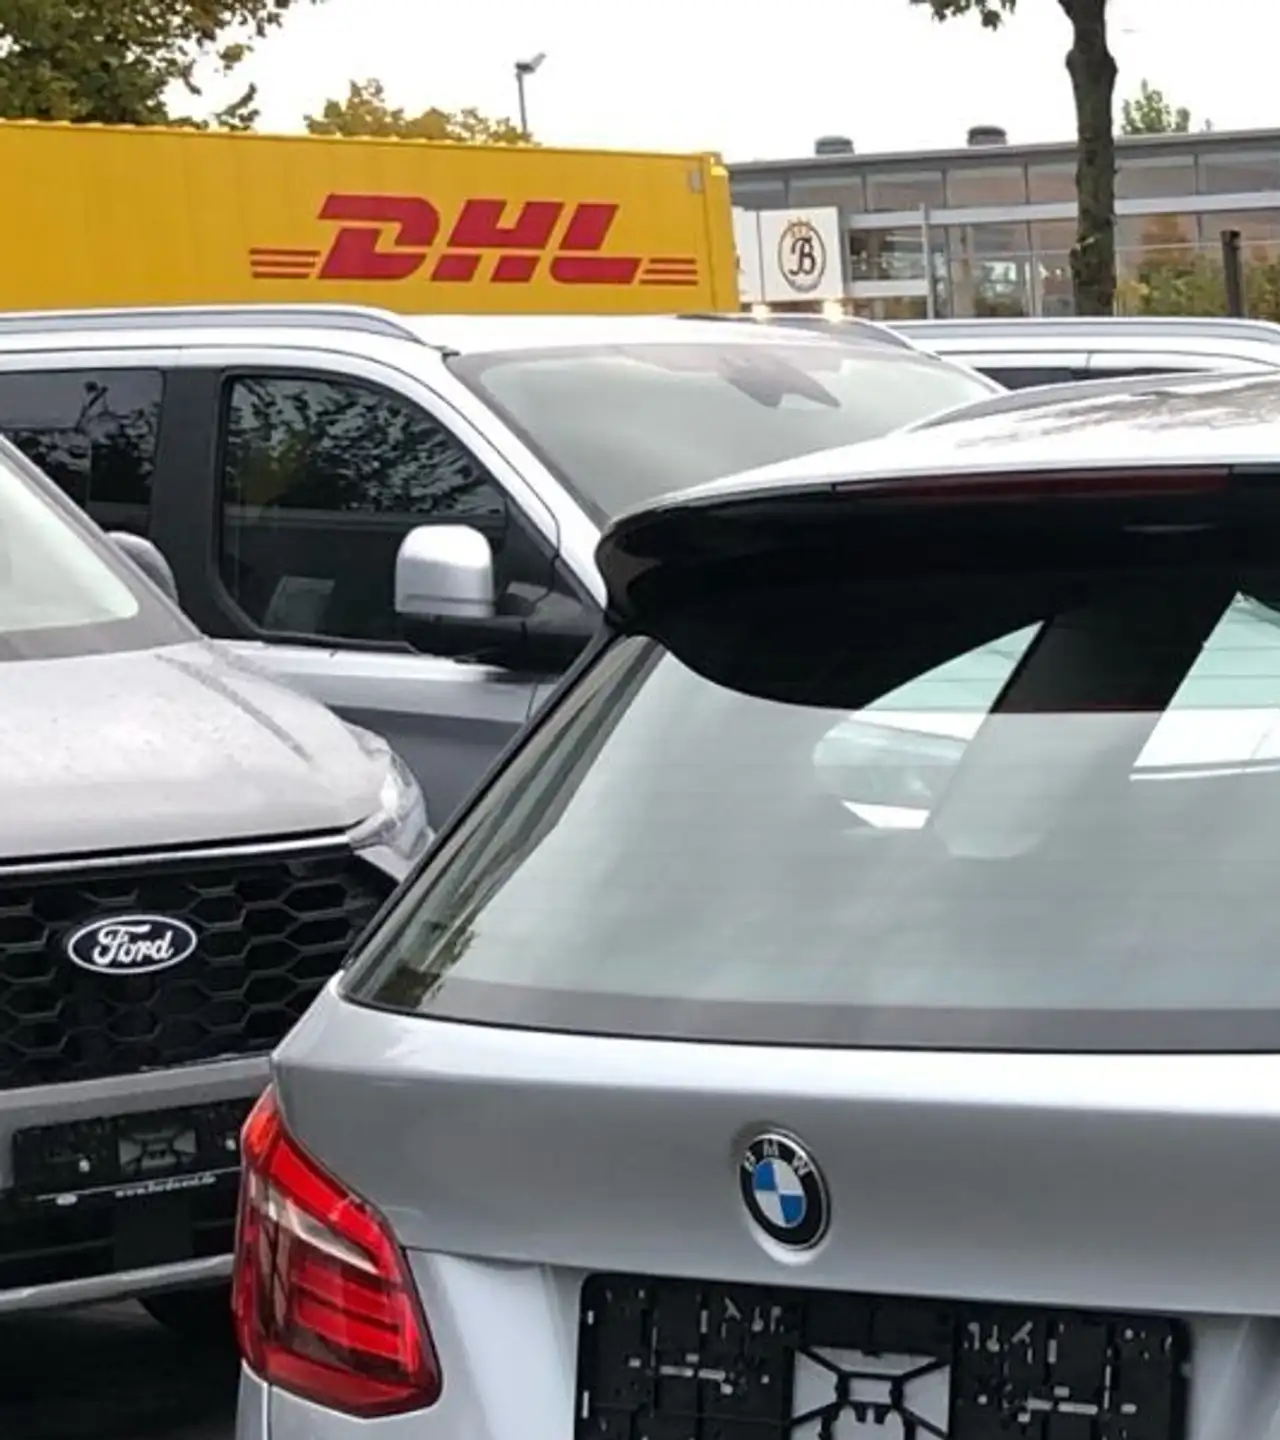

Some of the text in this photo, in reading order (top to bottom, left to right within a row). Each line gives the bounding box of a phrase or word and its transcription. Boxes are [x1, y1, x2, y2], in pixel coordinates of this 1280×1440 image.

[317, 193, 642, 285] DHL
[93, 923, 174, 966] Ford
[744, 1138, 813, 1177] BMW
